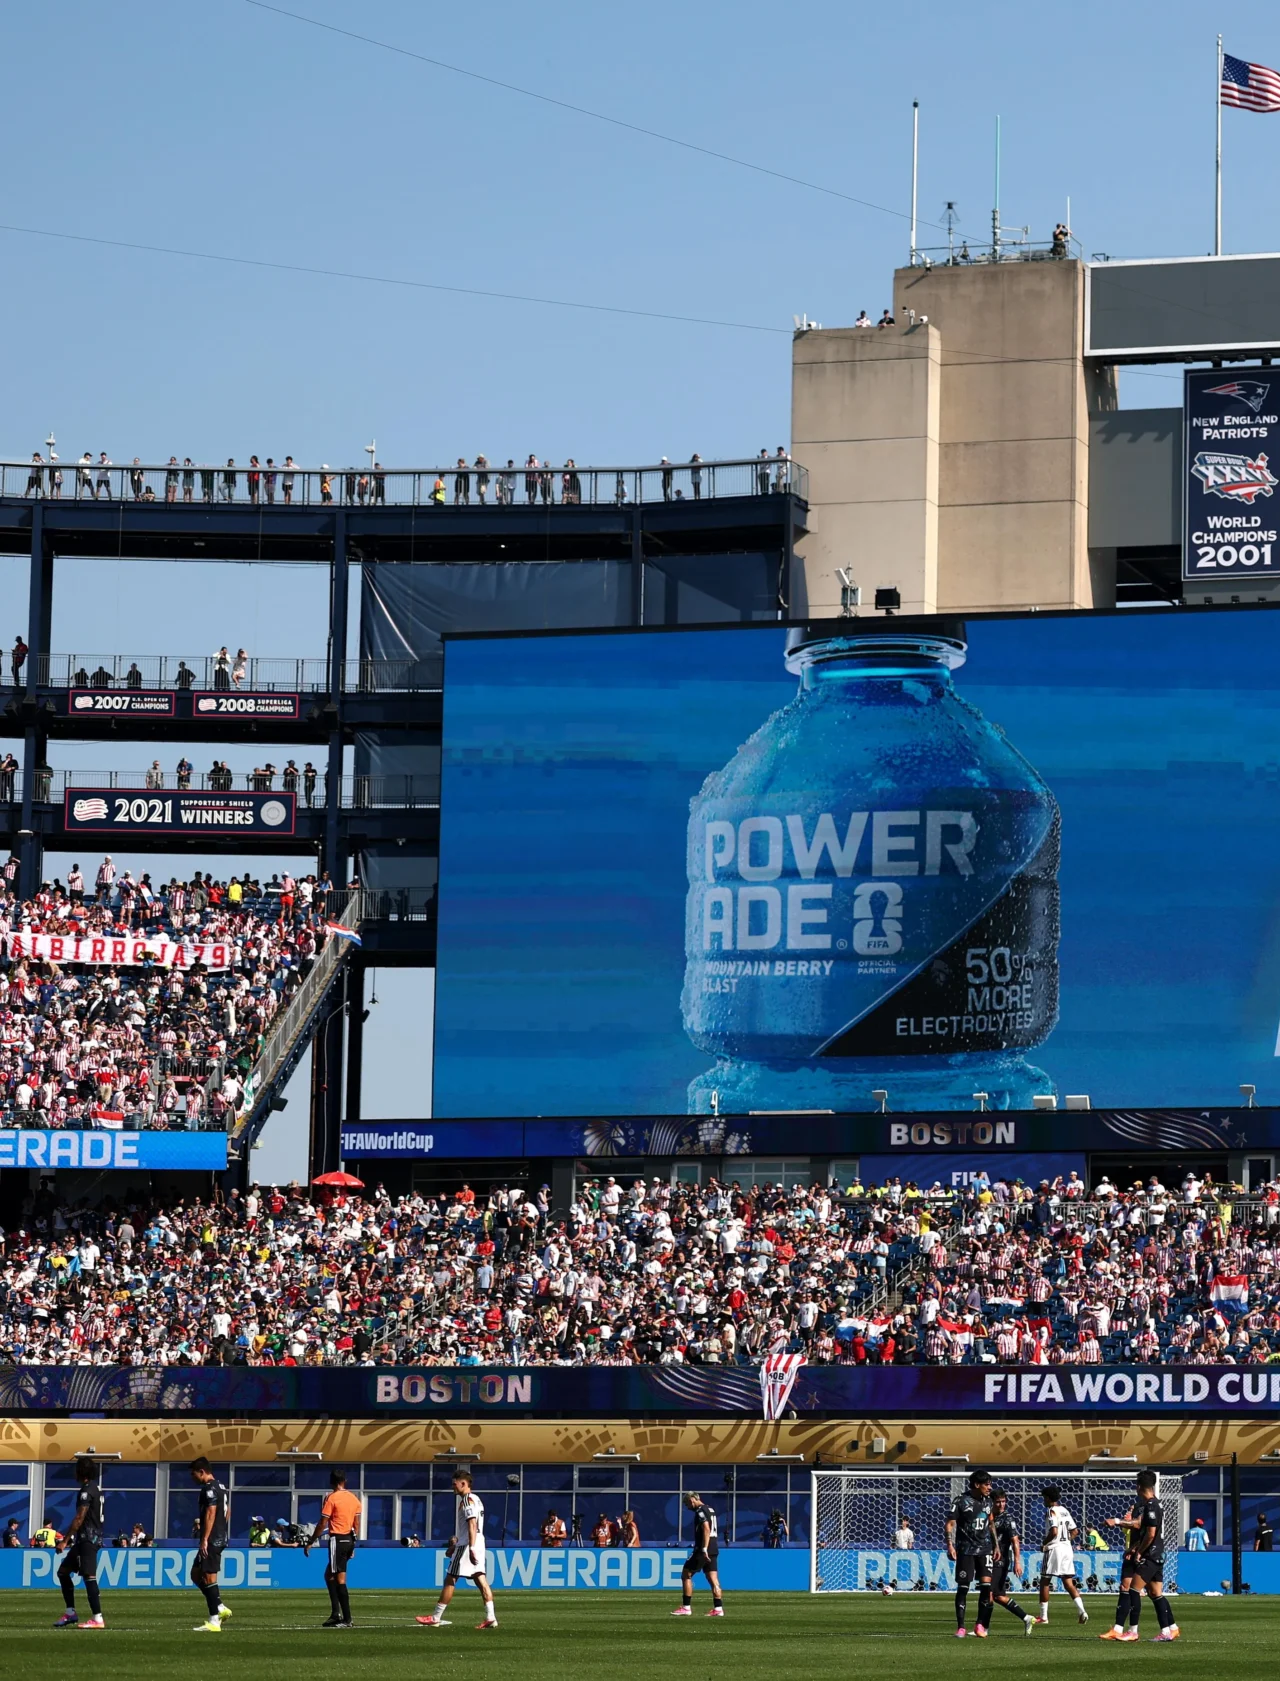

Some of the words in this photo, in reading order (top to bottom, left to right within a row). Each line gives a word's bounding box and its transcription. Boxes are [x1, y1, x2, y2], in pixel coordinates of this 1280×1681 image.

[1193, 417, 1219, 427] NEW
[1224, 415, 1278, 425] ENGLAND
[1203, 428, 1268, 440] PATRIOTS
[1205, 455, 1226, 464] SUPER
[1227, 457, 1245, 466] BOWL
[1207, 516, 1261, 528] WORLD
[1191, 531, 1277, 544] CHAMPIONS
[1196, 544, 1272, 568] 2001
[94, 696, 130, 710] 2007
[218, 699, 255, 712] 2008
[256, 705, 294, 713] CHAMPIONS
[114, 798, 172, 823] 2021
[180, 810, 254, 825] WINNERS
[706, 810, 977, 884] POWER
[703, 883, 833, 951] ADE
[867, 940, 889, 949] FIFA
[704, 960, 770, 976] MOUNTAIN
[774, 960, 834, 976] BERRY
[966, 947, 1033, 984] 50%
[702, 978, 738, 993] BLAST
[968, 984, 1032, 1012] MORE
[896, 1012, 1032, 1036] ELECTROLYTES
[890, 1121, 1015, 1146] BOSTON
[376, 1374, 532, 1403] BOSTON
[984, 1373, 1064, 1402] FIFA
[1069, 1373, 1210, 1402] WORLD
[975, 1518, 985, 1530] 15
[22, 1550, 272, 1587] PWERDE
[985, 1555, 993, 1567] 15
[858, 1551, 1122, 1592] POWADE
